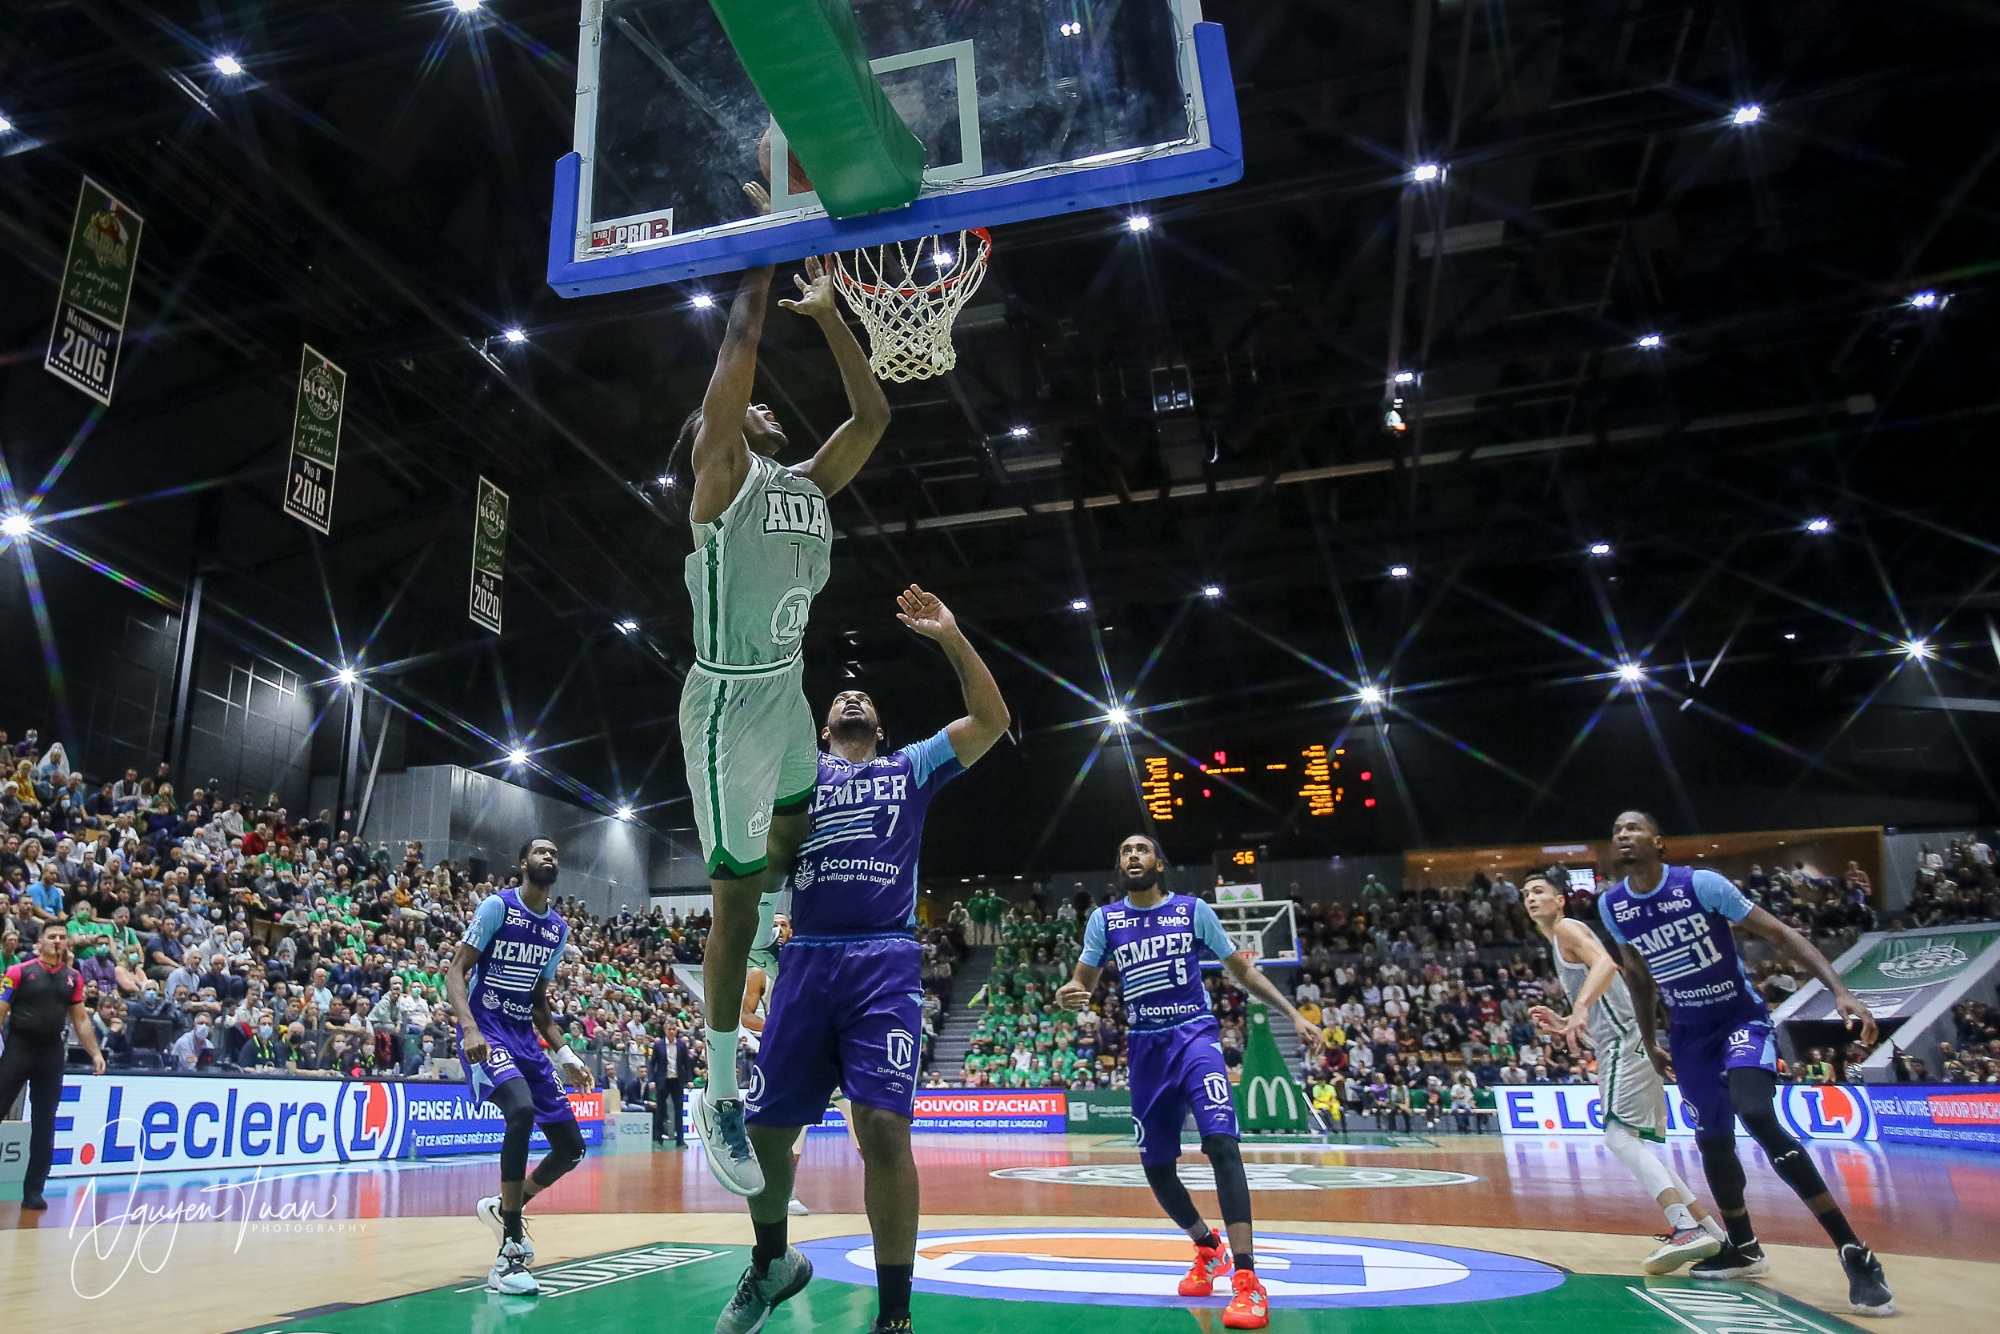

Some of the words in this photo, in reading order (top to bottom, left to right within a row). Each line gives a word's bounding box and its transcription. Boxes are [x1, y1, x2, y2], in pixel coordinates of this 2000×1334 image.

[59, 326, 107, 382] 2016
[303, 378, 339, 412] BLOIS
[293, 473, 326, 516] 2018
[481, 505, 505, 531] BLOIS
[763, 490, 827, 543] ADA
[789, 541, 801, 578] 7
[473, 584, 499, 620] 2020
[886, 805, 900, 838] 7
[820, 856, 899, 874] écomiam
[827, 872, 855, 883] village
[856, 872, 868, 881] du
[505, 916, 532, 929] SOFT
[1108, 917, 1141, 931] SOFT
[1157, 915, 1190, 927] SAMBO
[1615, 906, 1641, 923] SOFT
[1628, 912, 1710, 956] EMPER
[1691, 936, 1722, 970] 11
[1174, 957, 1188, 986] 5
[408, 1100, 453, 1121] PENSE
[453, 1096, 465, 1120] À
[913, 1099, 980, 1113] POUVOIR
[983, 1099, 1048, 1113] D'ACHAT
[1929, 1100, 1972, 1118] POUVOIR
